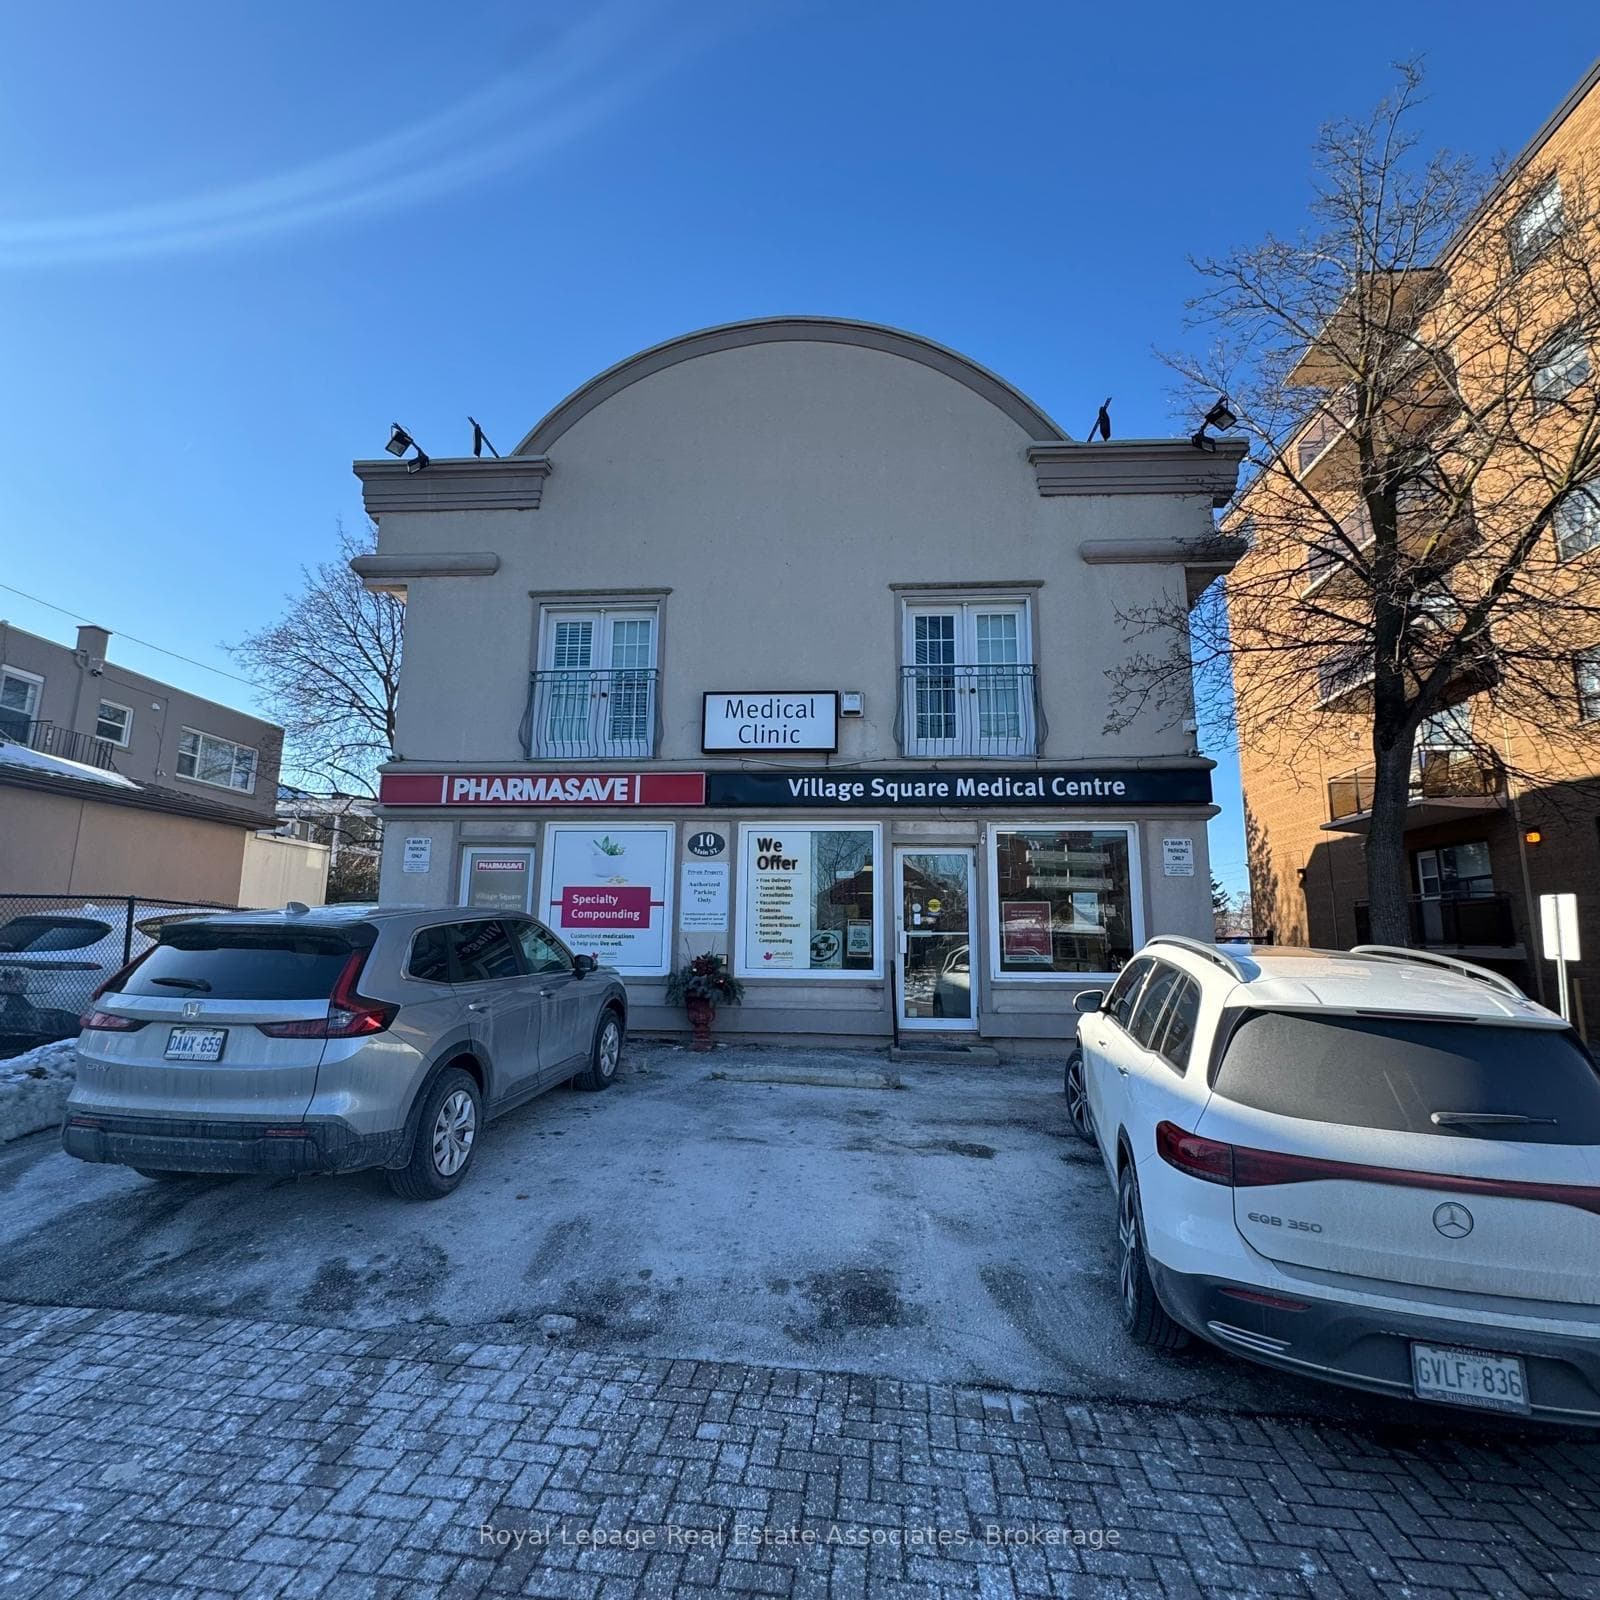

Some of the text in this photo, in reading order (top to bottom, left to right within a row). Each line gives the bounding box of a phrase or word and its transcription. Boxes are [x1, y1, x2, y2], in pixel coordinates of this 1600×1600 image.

[725, 698, 815, 719] Medical
[738, 723, 801, 744] Clinic
[452, 777, 629, 801] PHARMASAVE
[787, 777, 1126, 802] Village Square Medical Centre
[698, 834, 715, 847] 10
[757, 838, 783, 852] We
[478, 862, 523, 870] PHARMASAVE
[757, 855, 798, 870] Offer
[572, 894, 619, 906] Specialty
[571, 909, 641, 921] Compounding
[168, 1035, 222, 1053] DAWX 659
[1247, 1212, 1322, 1234] EQB 350
[1481, 1365, 1521, 1397] 836
